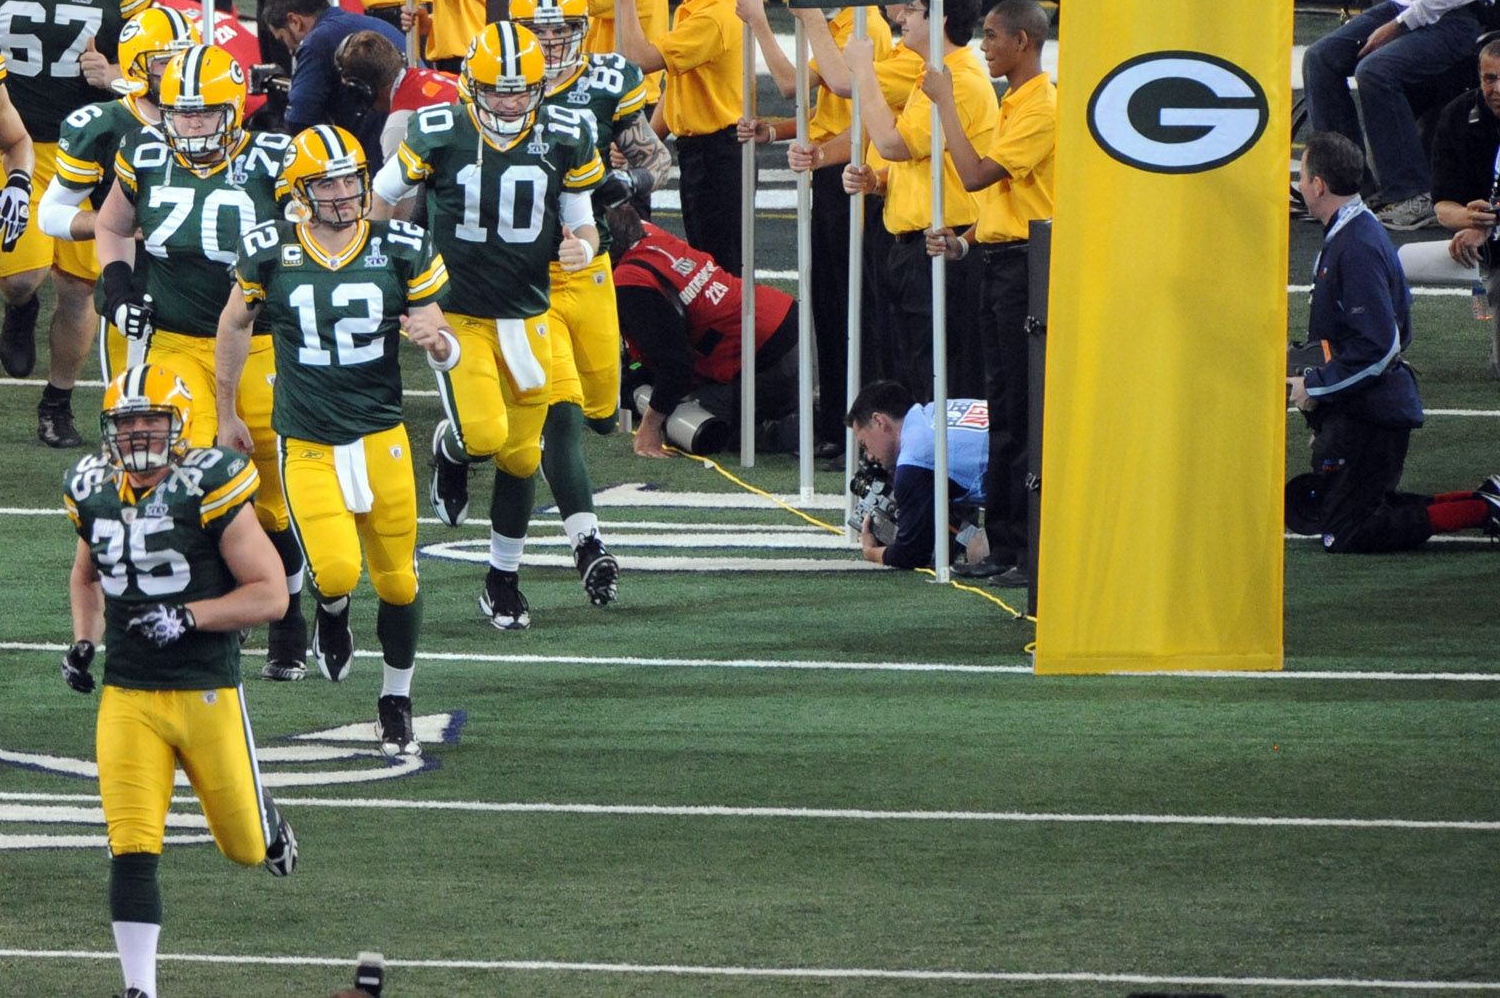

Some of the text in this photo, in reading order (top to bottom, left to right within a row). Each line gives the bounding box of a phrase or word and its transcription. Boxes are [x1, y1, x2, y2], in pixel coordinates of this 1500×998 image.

[1094, 58, 1260, 167] G
[245, 132, 292, 177] 70
[145, 186, 257, 264] 70
[455, 164, 549, 243] 10
[289, 282, 384, 365] 12
[91, 517, 191, 596] 35
